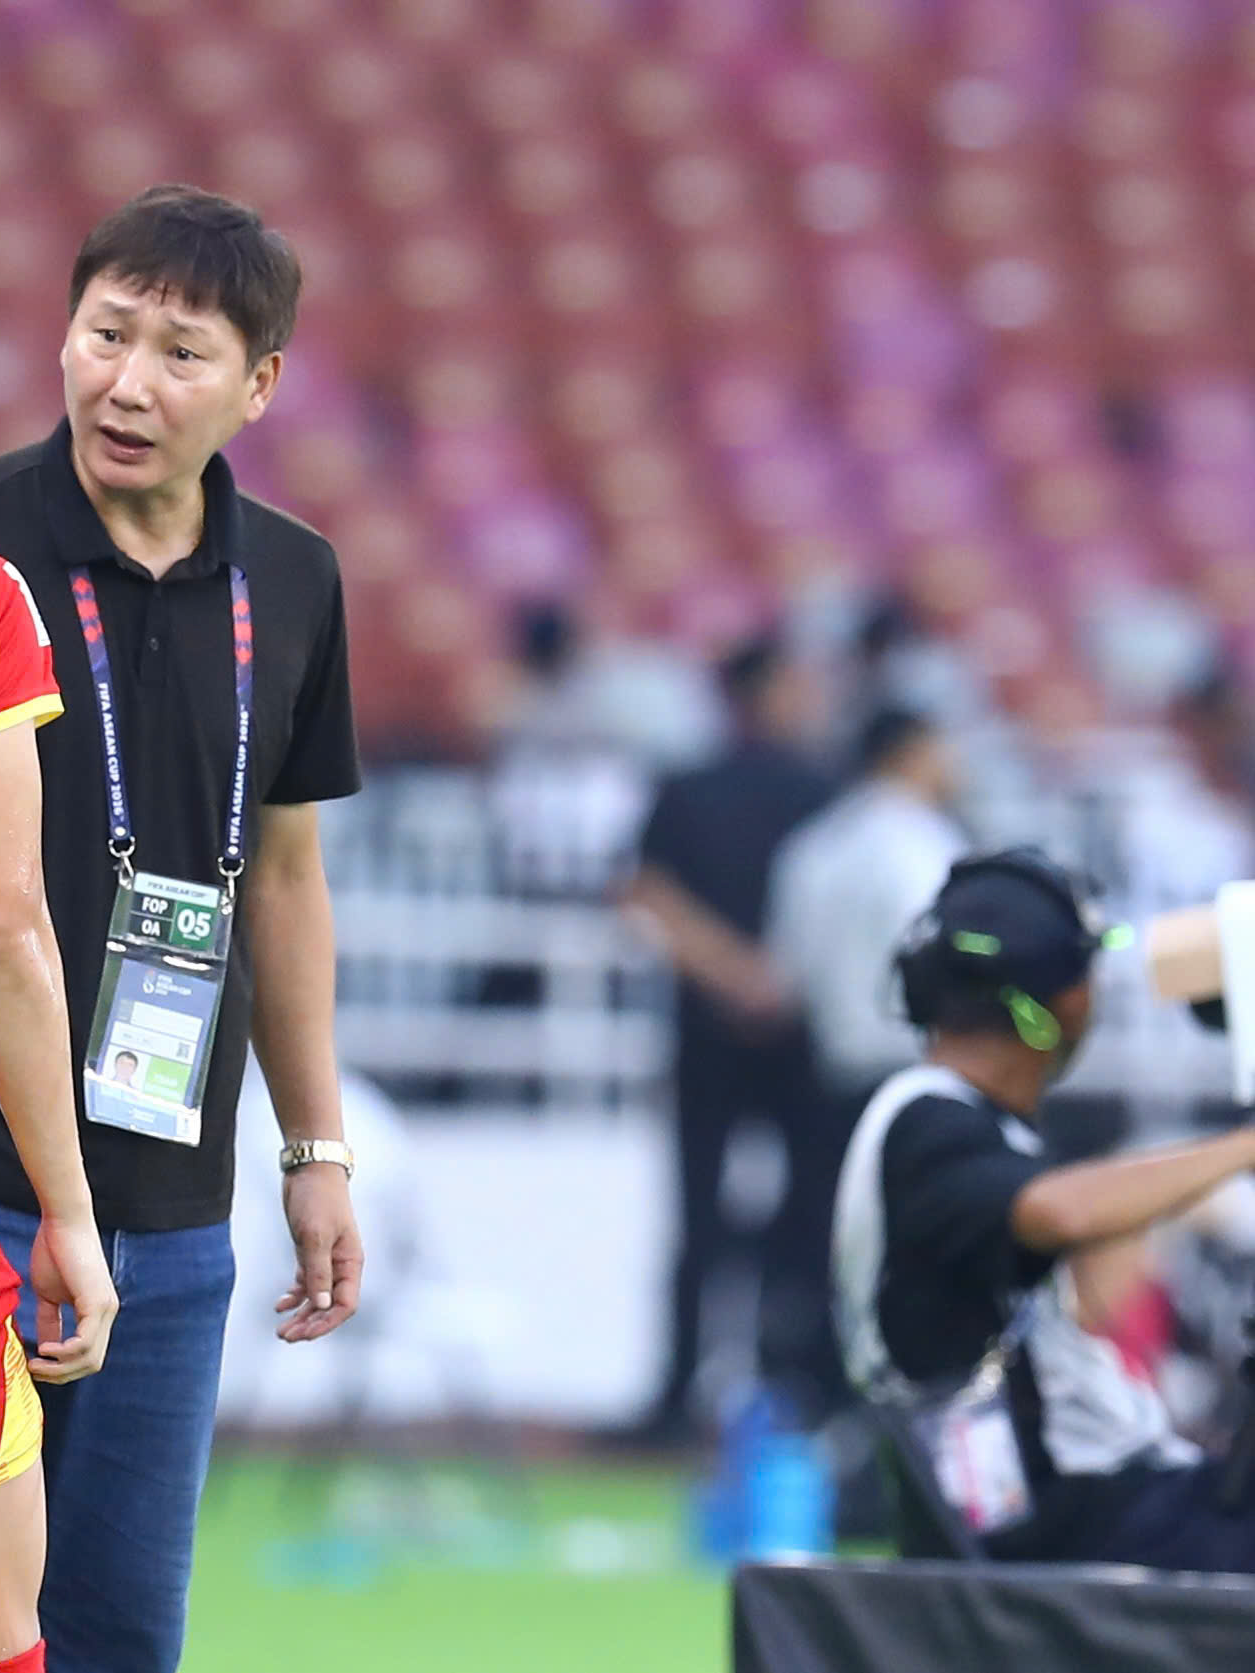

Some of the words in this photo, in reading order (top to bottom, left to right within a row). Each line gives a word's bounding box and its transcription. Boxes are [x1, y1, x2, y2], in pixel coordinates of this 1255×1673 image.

[98, 682, 112, 711] FIFA
[102, 712, 117, 756] ASEAN
[107, 756, 121, 783] CUP
[236, 744, 247, 771] CUP
[232, 771, 245, 815] ASEAN
[229, 815, 242, 844] FIFA
[142, 896, 169, 915] FOP
[141, 919, 161, 937] OA
[177, 908, 212, 938] 05
